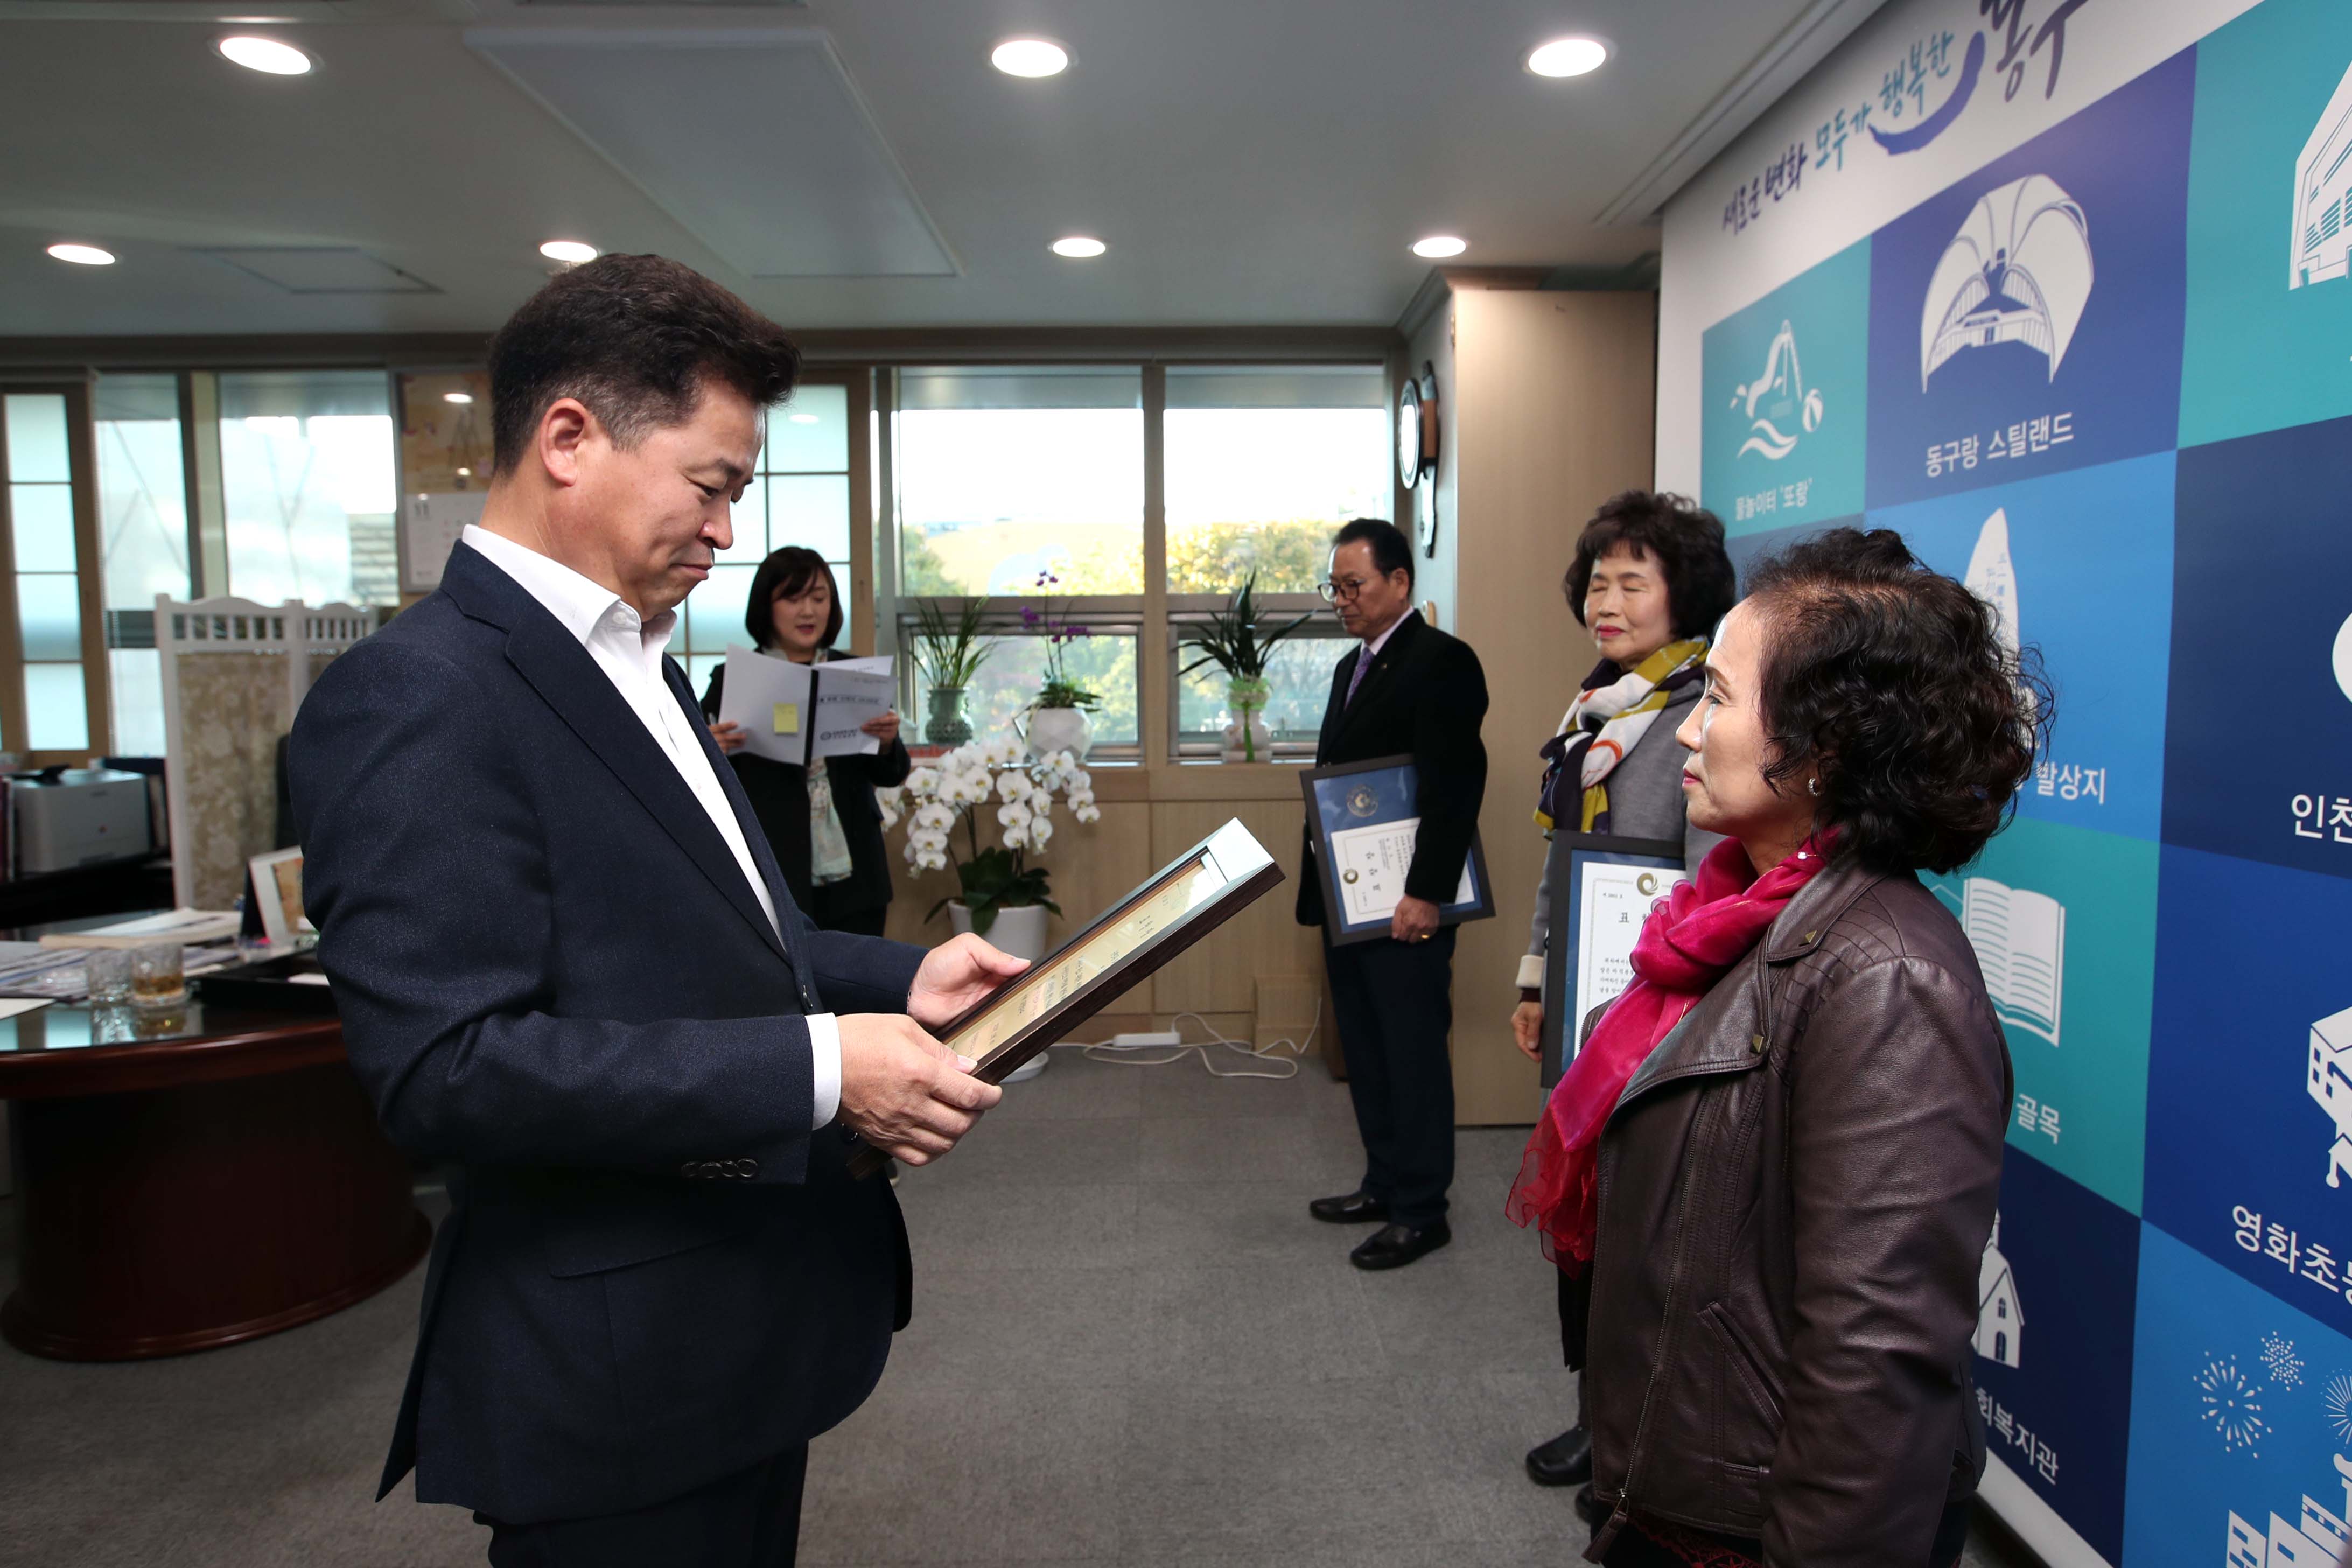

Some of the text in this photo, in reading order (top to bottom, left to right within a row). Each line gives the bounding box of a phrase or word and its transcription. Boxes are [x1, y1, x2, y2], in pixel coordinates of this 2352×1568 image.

[1765, 143, 1808, 201] 변화
[1815, 102, 1872, 171] 모두가
[1879, 31, 1954, 118] 행복한
[1926, 412, 2074, 478] 동구랑 스틸랜드
[2035, 761, 2106, 805] 발상지
[2017, 1093, 2061, 1145] 골목
[1971, 1377, 2059, 1487] 회복지관
